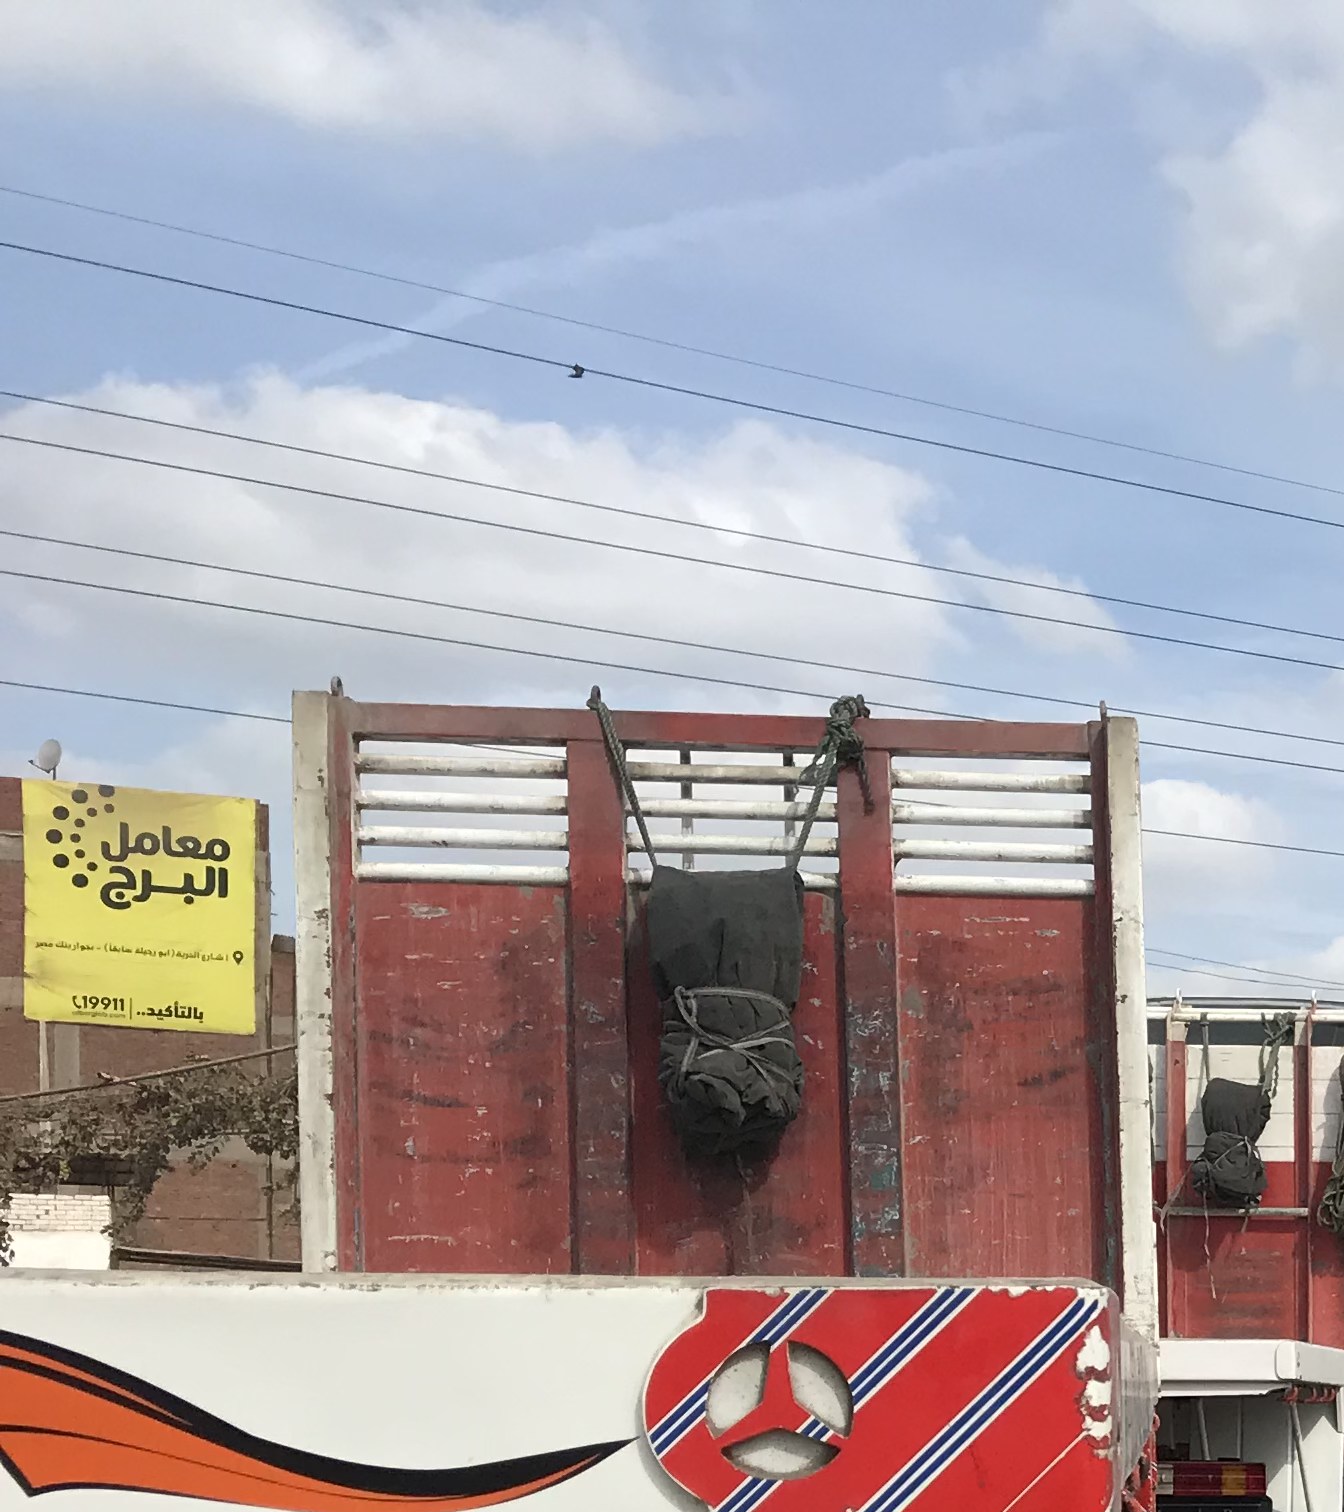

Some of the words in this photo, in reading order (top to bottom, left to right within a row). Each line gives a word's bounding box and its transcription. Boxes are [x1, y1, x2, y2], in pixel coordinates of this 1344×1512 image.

[101, 821, 231, 863] معامل
[100, 865, 229, 910] البرج
[201, 952, 224, 962] شارع
[82, 995, 125, 1011] 19911
